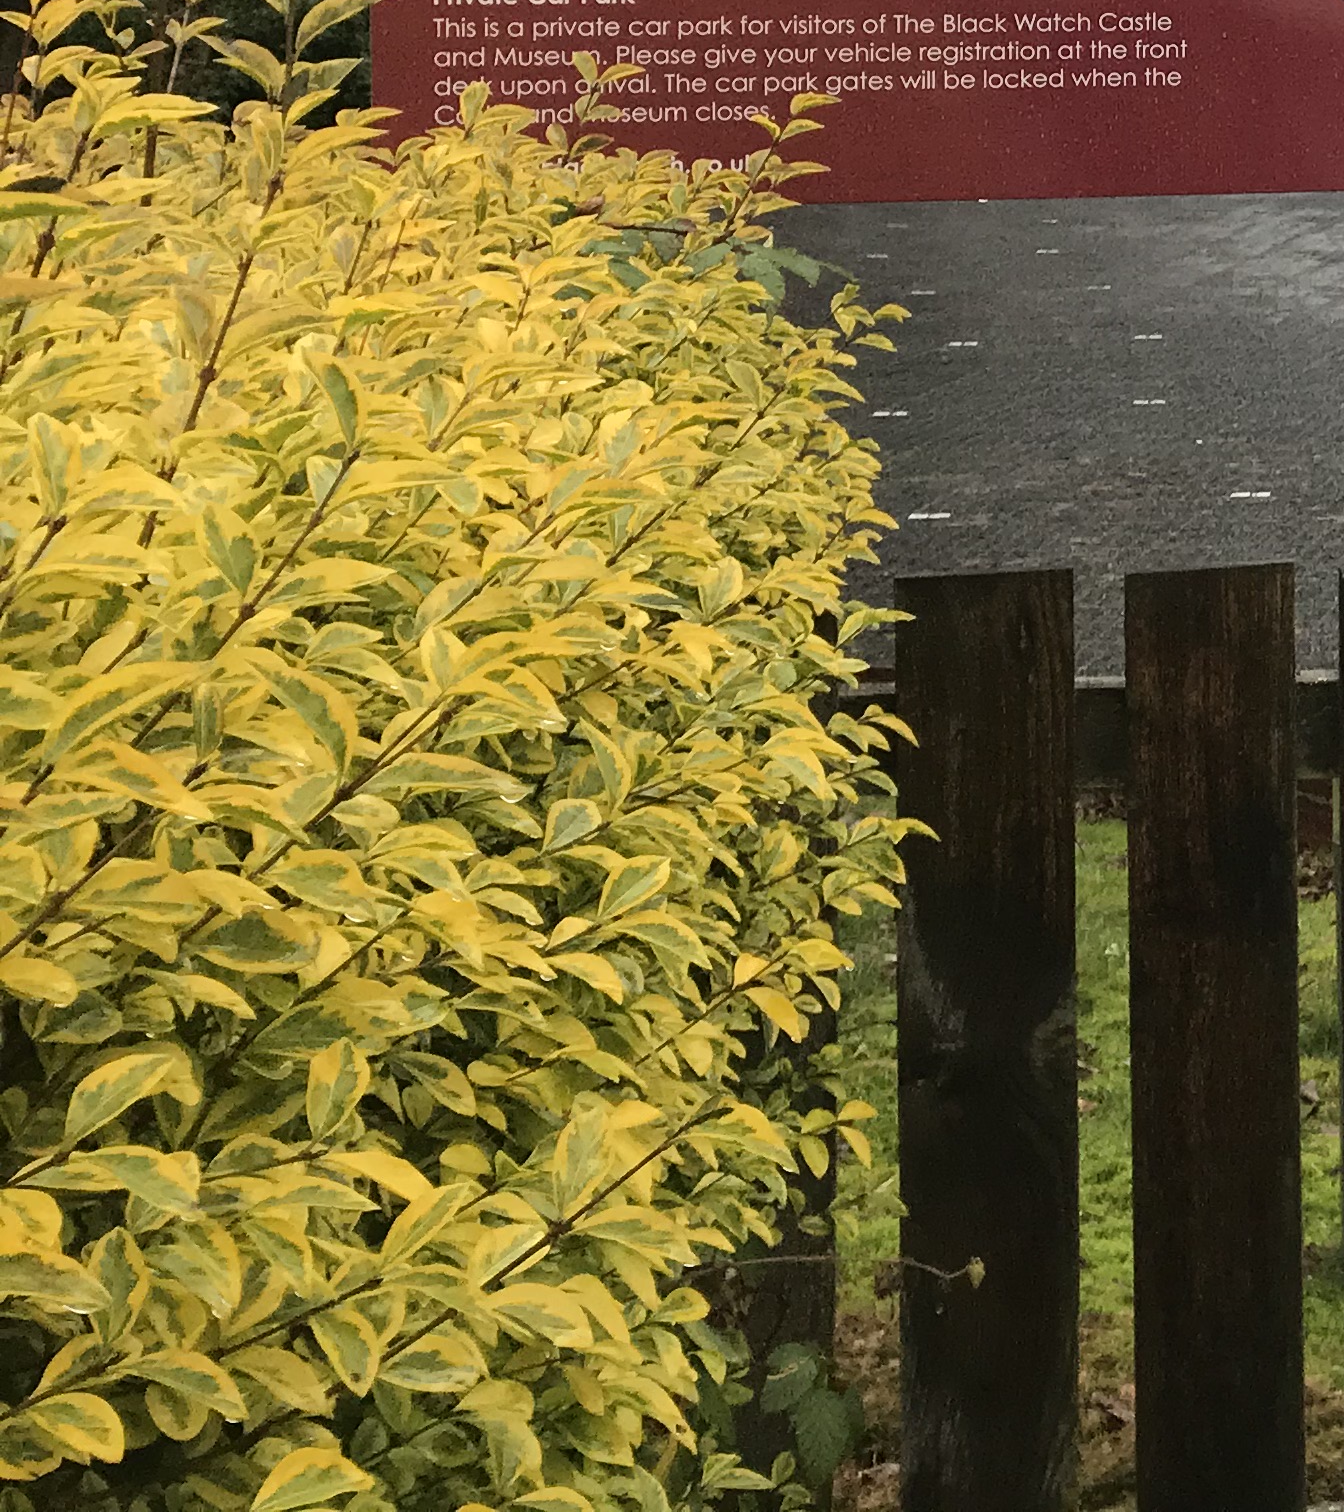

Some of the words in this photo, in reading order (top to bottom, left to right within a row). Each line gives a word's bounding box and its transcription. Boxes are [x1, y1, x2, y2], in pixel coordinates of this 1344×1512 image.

[432, 16, 477, 38] This
[483, 16, 500, 38] is
[507, 21, 524, 38] a
[532, 16, 621, 42] private
[628, 20, 671, 37] car
[677, 15, 733, 40] park
[740, 14, 774, 35] for
[778, 14, 856, 35] visitors
[862, 13, 887, 34] of
[892, 13, 935, 34] The
[943, 13, 1007, 34] Black
[1013, 12, 1091, 33] Watch
[1098, 11, 1172, 32] Castle
[433, 46, 485, 68] and
[493, 47, 608, 67] Museu.
[616, 44, 697, 65] Please
[704, 43, 757, 69] give
[763, 47, 818, 68] your
[824, 42, 912, 63] vehicle
[919, 40, 1050, 66] registration
[1057, 40, 1083, 60] at
[1089, 39, 1128, 60] the
[1134, 39, 1188, 59] front
[434, 75, 493, 97] de
[500, 79, 567, 100] upon
[574, 73, 657, 99] arival.
[663, 73, 707, 94] The
[715, 76, 757, 93] car
[764, 71, 818, 96] park
[825, 71, 894, 96] gates
[899, 69, 936, 90] will
[943, 69, 976, 90] be
[983, 67, 1064, 89] locked
[1071, 67, 1137, 87] when
[1144, 67, 1182, 87] the
[695, 101, 776, 122] closes.
